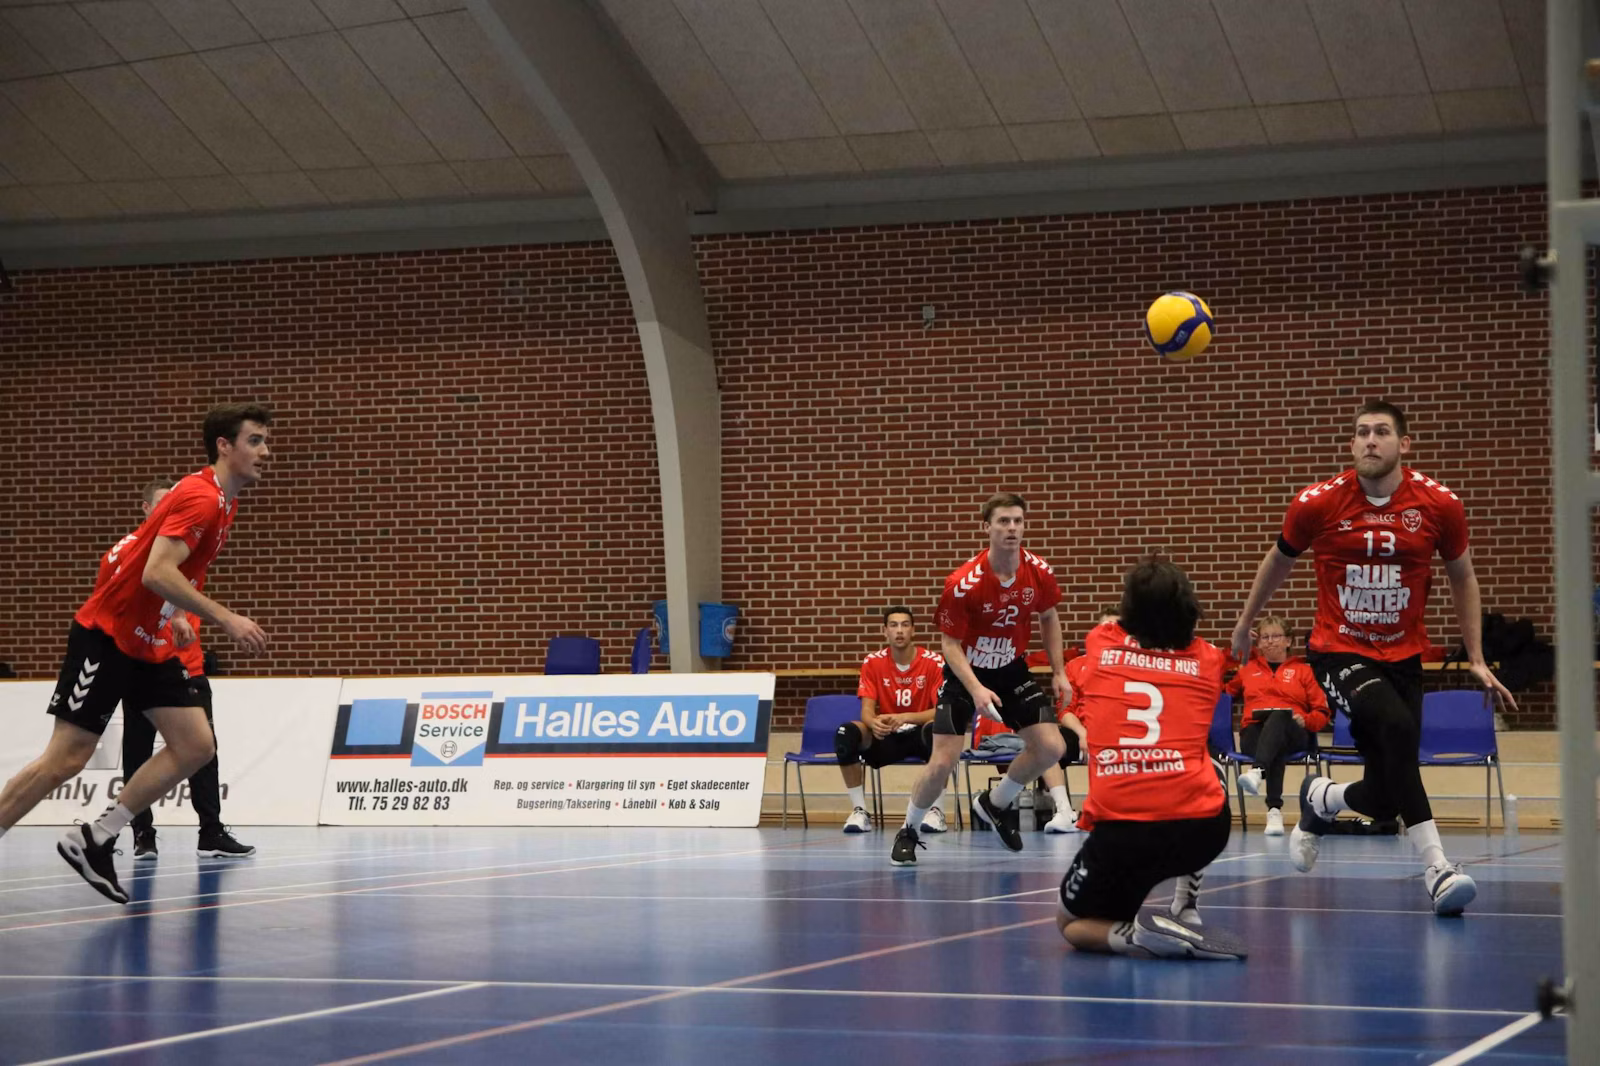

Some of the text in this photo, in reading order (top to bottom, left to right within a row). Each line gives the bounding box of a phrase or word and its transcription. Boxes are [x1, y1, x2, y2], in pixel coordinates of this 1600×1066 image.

[1379, 513, 1396, 522] LCC
[1363, 530, 1396, 557] 13
[1346, 564, 1402, 589] BLUE
[1336, 584, 1411, 611] WATER
[992, 605, 1019, 628] 22
[1344, 610, 1400, 625] SHIPPING
[966, 645, 1017, 669] WATER
[1100, 650, 1198, 676] DET FAGLIGE HUS
[895, 688, 912, 707] 18
[422, 704, 487, 720] BOSCH
[514, 701, 747, 738] Halles Auto
[1119, 681, 1164, 745] 3
[419, 722, 484, 738] Service
[1120, 748, 1183, 760] TOYOTA
[1096, 758, 1185, 777] Louis Lund
[336, 778, 469, 794] www.halles-auto.dk
[493, 779, 750, 791] Rep. og service Klargøring til syn Eget skadecenter
[348, 796, 450, 811] Tlf. 75 29 82 83
[516, 798, 721, 811] Bugsering/Taksering Lånebil Køb & Salg
